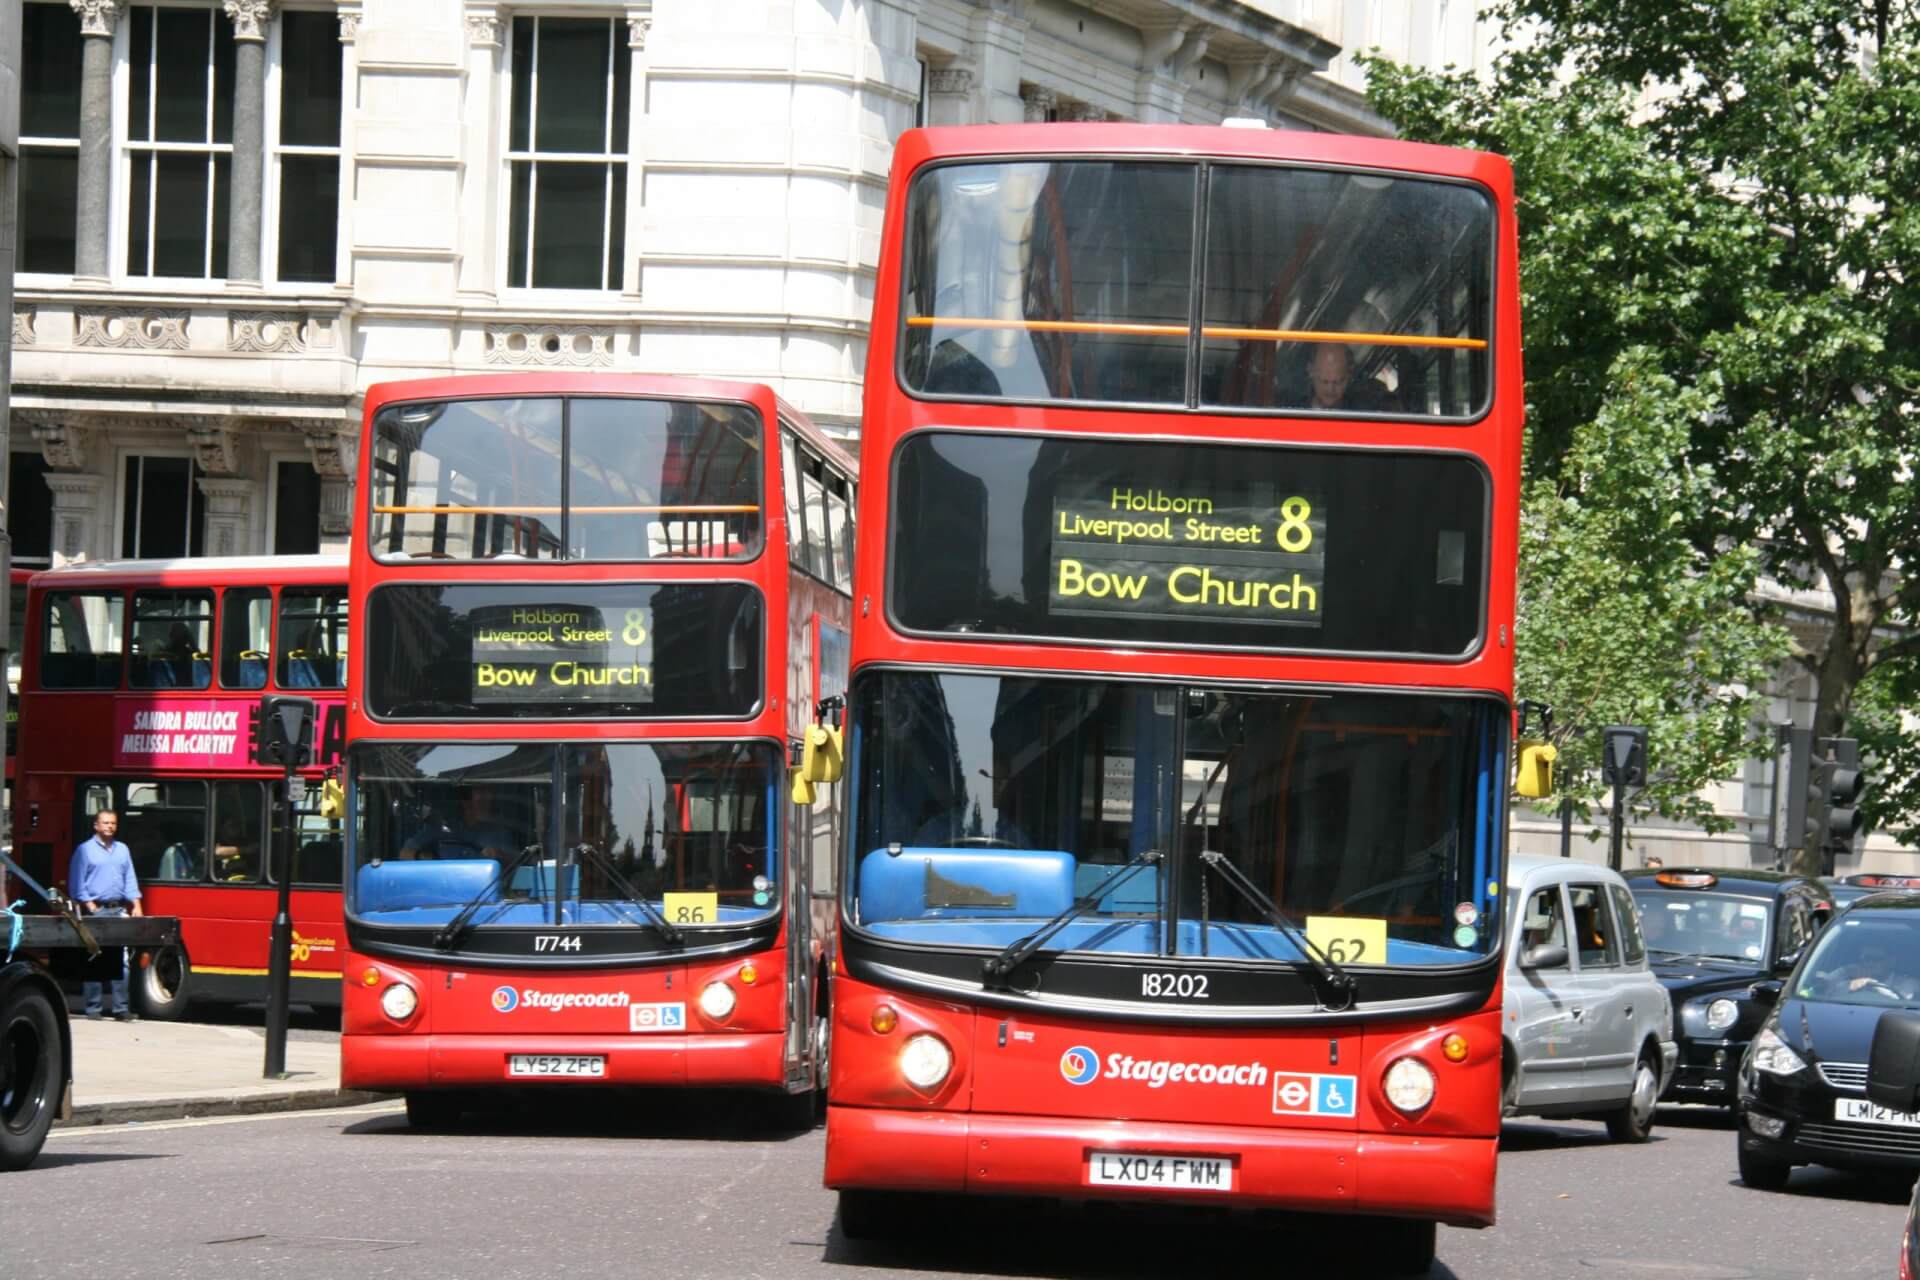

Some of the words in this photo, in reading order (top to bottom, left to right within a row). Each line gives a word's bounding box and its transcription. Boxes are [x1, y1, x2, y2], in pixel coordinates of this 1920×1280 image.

[1111, 487, 1213, 514] Holborn
[1059, 511, 1173, 543] Liverpool
[1185, 518, 1262, 543] Street
[1277, 496, 1312, 552] 8
[1058, 559, 1148, 599] Bow
[1168, 566, 1316, 611] Church
[512, 609, 580, 624] Holborn
[622, 608, 646, 646] 8
[479, 627, 554, 645] Liverpool
[561, 626, 612, 642] Street
[477, 663, 537, 686] Bow
[550, 661, 650, 685] Church
[133, 711, 181, 731] SANDRA
[184, 711, 239, 731] BULLOCK
[121, 734, 169, 753] MELISSA
[172, 734, 237, 755] McCARTHY
[677, 906, 705, 923] 86
[534, 935, 582, 951] 17744
[1327, 938, 1366, 964] 62
[1142, 973, 1209, 998] 18202
[521, 989, 630, 1012] Stagecoach
[513, 1057, 561, 1073] LY52
[566, 1058, 601, 1074] ZFC
[1104, 1053, 1268, 1088] Stagecoach
[1101, 1156, 1165, 1182] LX04
[1172, 1159, 1221, 1185] FWM
